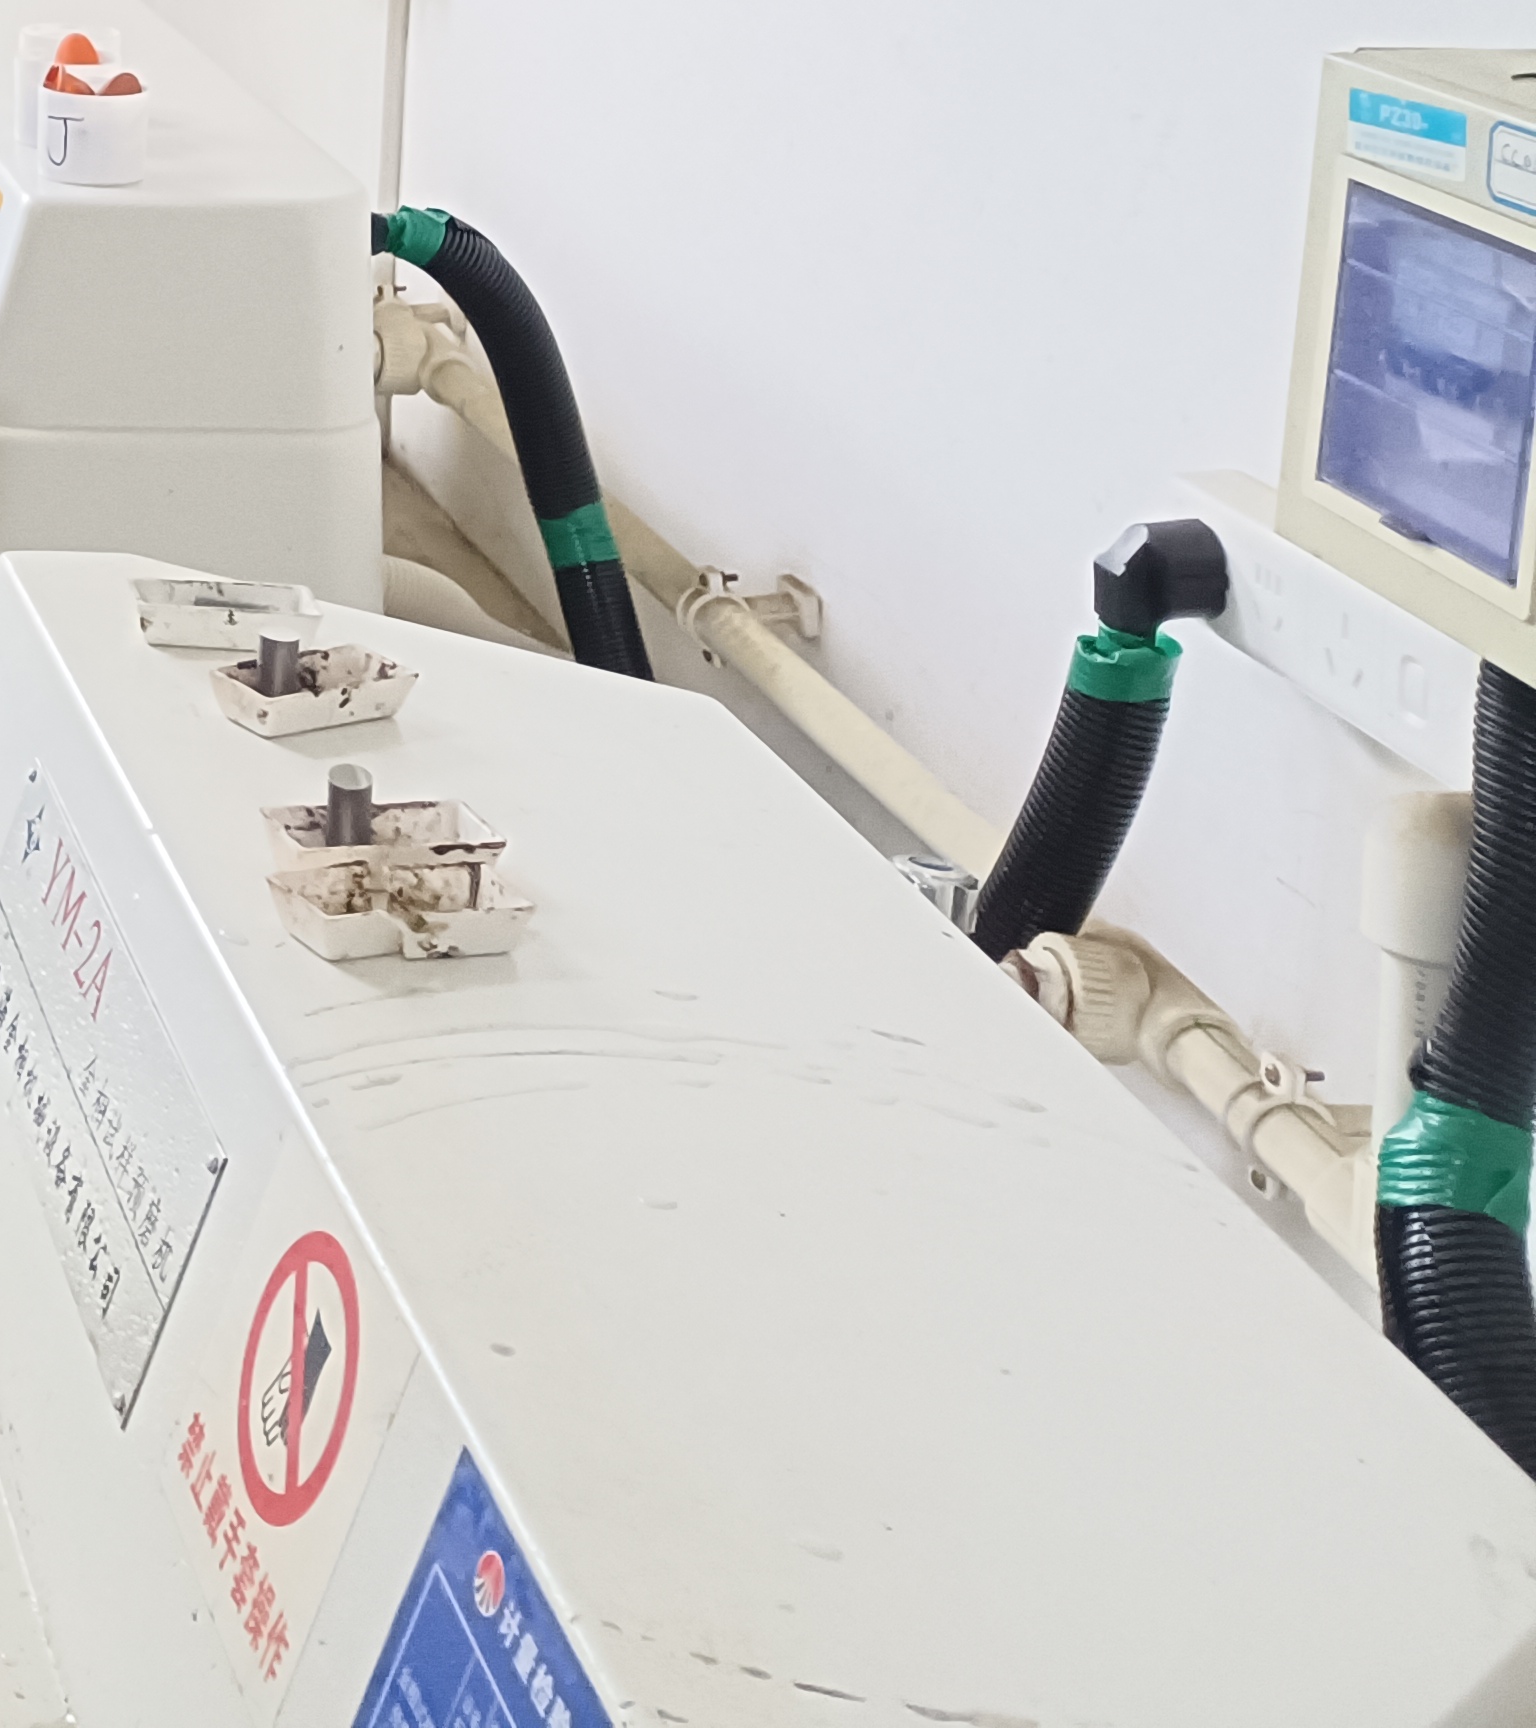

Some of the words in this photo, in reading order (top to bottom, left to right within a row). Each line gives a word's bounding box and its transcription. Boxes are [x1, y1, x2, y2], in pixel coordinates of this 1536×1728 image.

[47, 115, 85, 166] J
[41, 836, 114, 1024] YM-2A
[178, 1412, 290, 1682] 禁止戴手套操作
